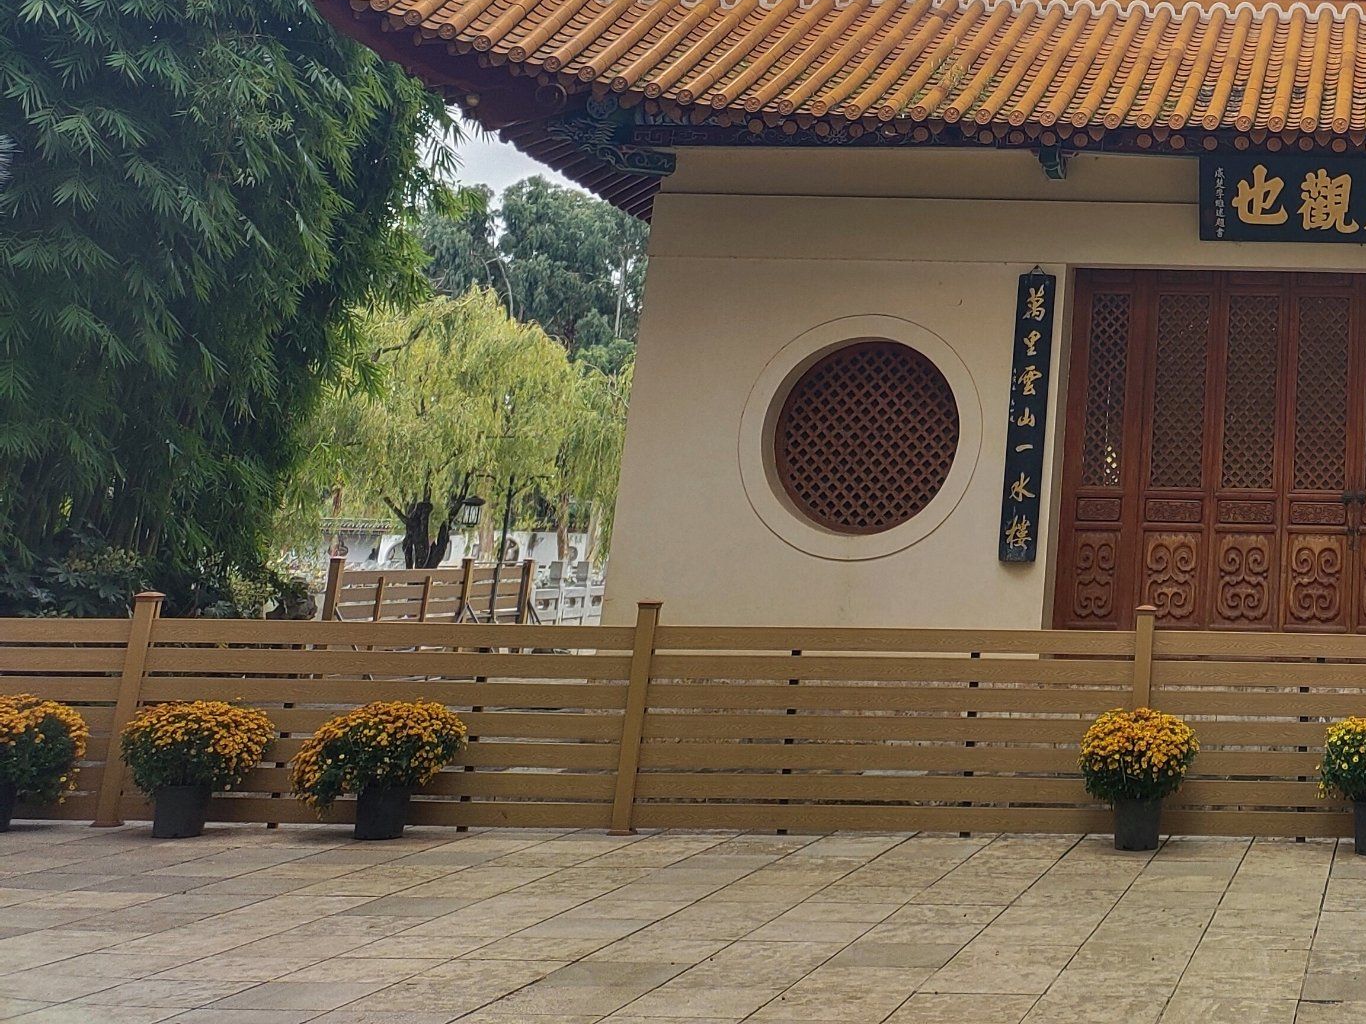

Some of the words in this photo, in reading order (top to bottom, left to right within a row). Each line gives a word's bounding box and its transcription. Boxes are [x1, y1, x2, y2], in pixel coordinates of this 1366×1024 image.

[1004, 284, 1046, 551] 萬里雲山一水樓
